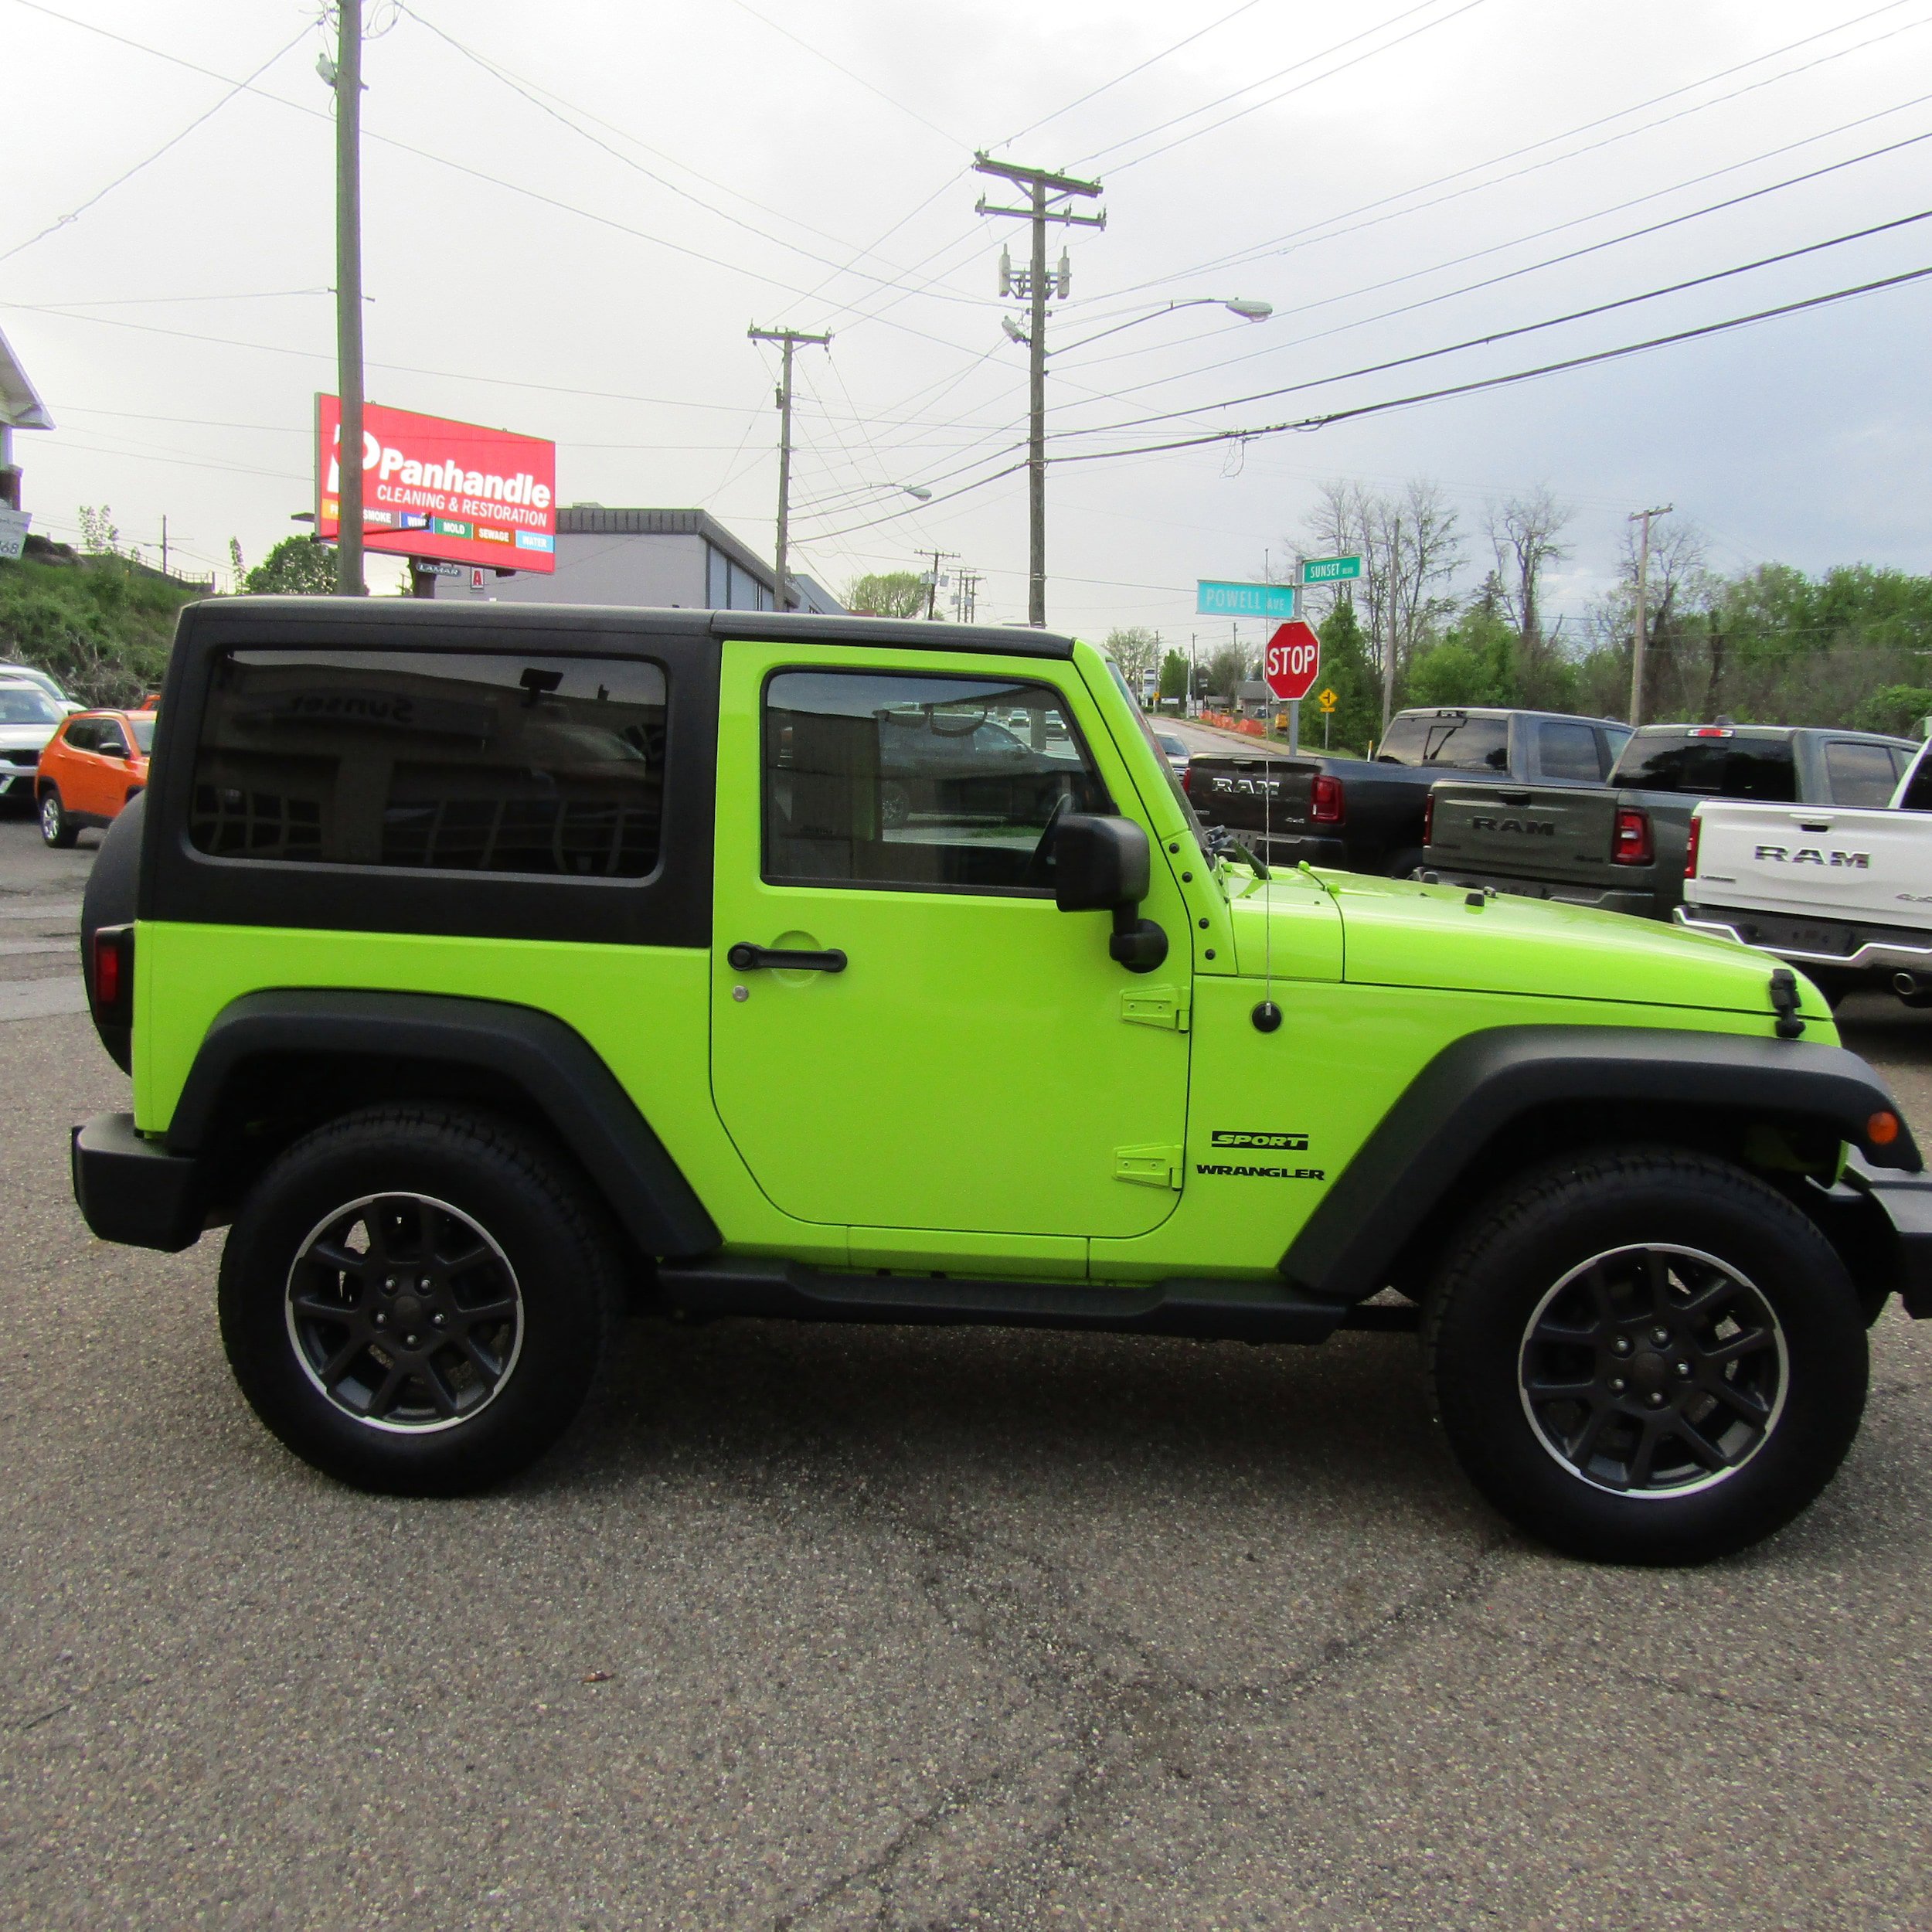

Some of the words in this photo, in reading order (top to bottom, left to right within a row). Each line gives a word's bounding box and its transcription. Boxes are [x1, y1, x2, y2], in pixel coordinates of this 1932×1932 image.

[379, 447, 551, 508] Panhandle
[377, 484, 445, 510] CLEANING
[449, 497, 458, 512] &
[461, 498, 547, 528] RESTORATION
[363, 509, 392, 524] SMOKE
[407, 515, 427, 526] WIN
[443, 521, 465, 535] MOLD
[478, 528, 509, 543] SEWAGE
[522, 536, 547, 548] WATER
[419, 564, 458, 575] LAMAR
[1310, 563, 1340, 578] SUNSET
[1206, 588, 1261, 609] POWELL
[1267, 598, 1284, 611] AVE
[1267, 645, 1315, 676] STOP
[1212, 777, 1281, 796] RAM
[1472, 816, 1555, 836] RAM
[1754, 843, 1871, 869] RAM
[1212, 1132, 1308, 1148] SPORT
[1196, 1165, 1325, 1181] WRANGLER
